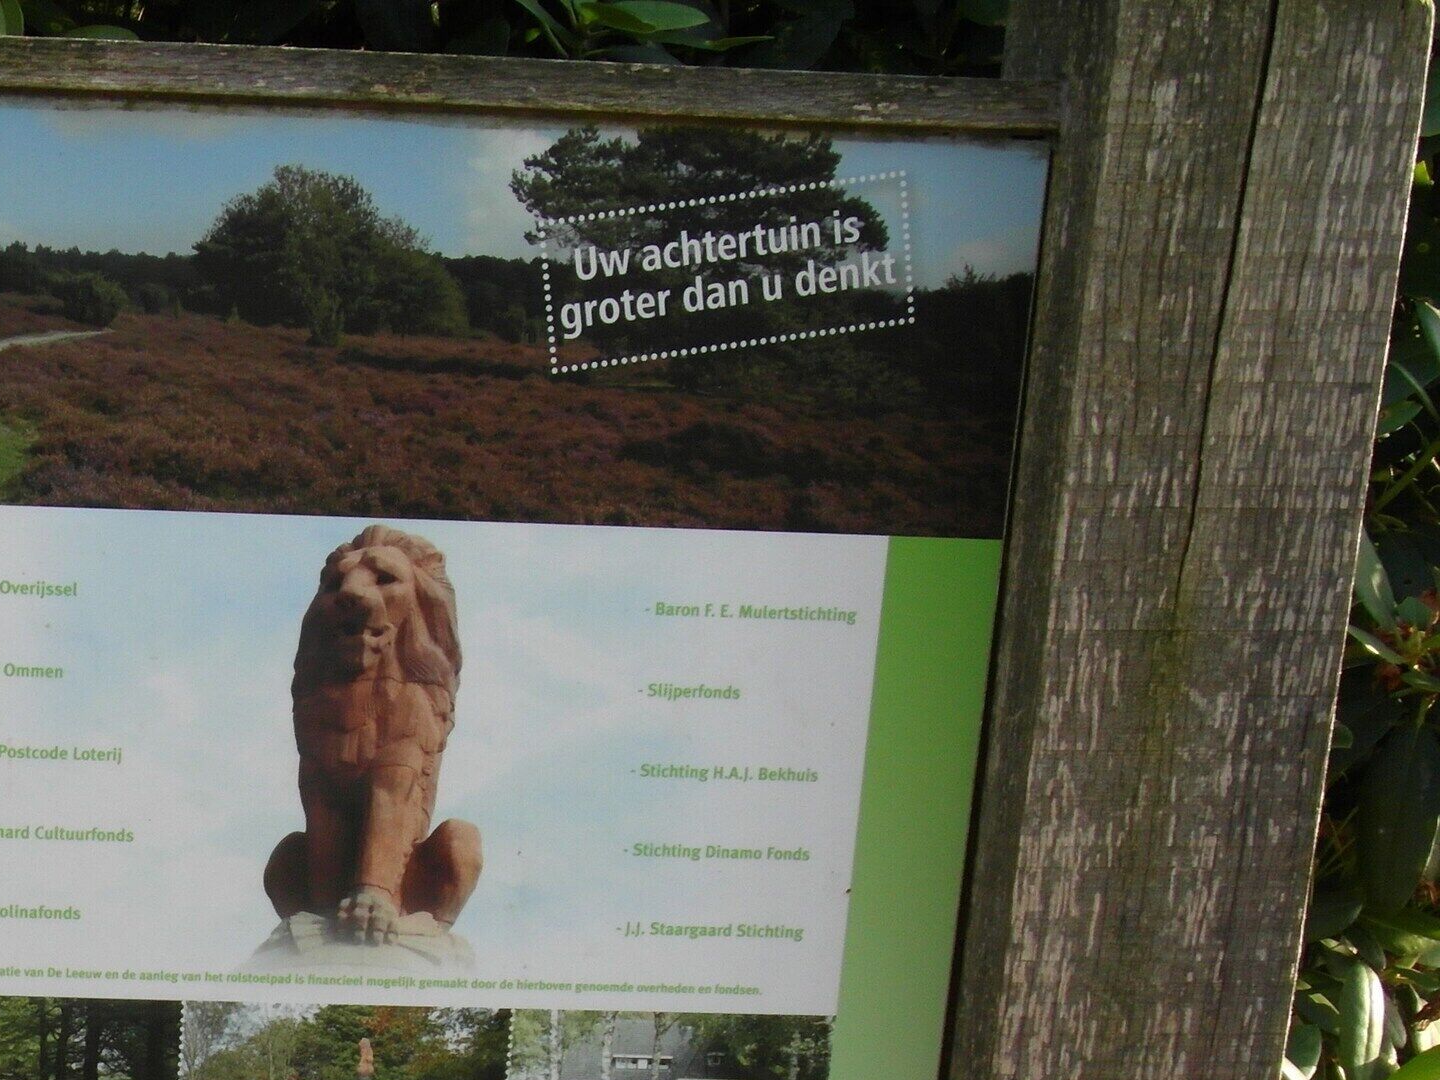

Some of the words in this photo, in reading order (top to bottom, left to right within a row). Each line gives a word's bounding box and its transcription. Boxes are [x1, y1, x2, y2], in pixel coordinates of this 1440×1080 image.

[574, 245, 630, 282] Uw
[642, 215, 820, 272] achtertuin
[833, 210, 860, 244] is
[561, 287, 670, 340] groter
[682, 276, 749, 314] dan
[763, 275, 782, 301] u
[795, 253, 896, 297] denkt
[655, 601, 699, 616] Baron
[704, 603, 714, 616] F.
[720, 604, 732, 617] E.
[738, 604, 857, 625] Mulertstichting
[3, 663, 63, 678] Ommen
[647, 683, 740, 701] Slijperfonds
[73, 747, 121, 764] Loterij
[640, 763, 709, 781] Stichting
[713, 766, 752, 782] H.A.J.
[757, 767, 818, 782] Bekhuis
[34, 826, 134, 842] Cultuurfonds
[633, 843, 701, 861] Stichting
[705, 845, 762, 859] Dinamo
[767, 846, 810, 860] Fonds
[624, 922, 644, 937] J.J.
[649, 921, 732, 939] Staargaard
[736, 923, 804, 941] Stichting
